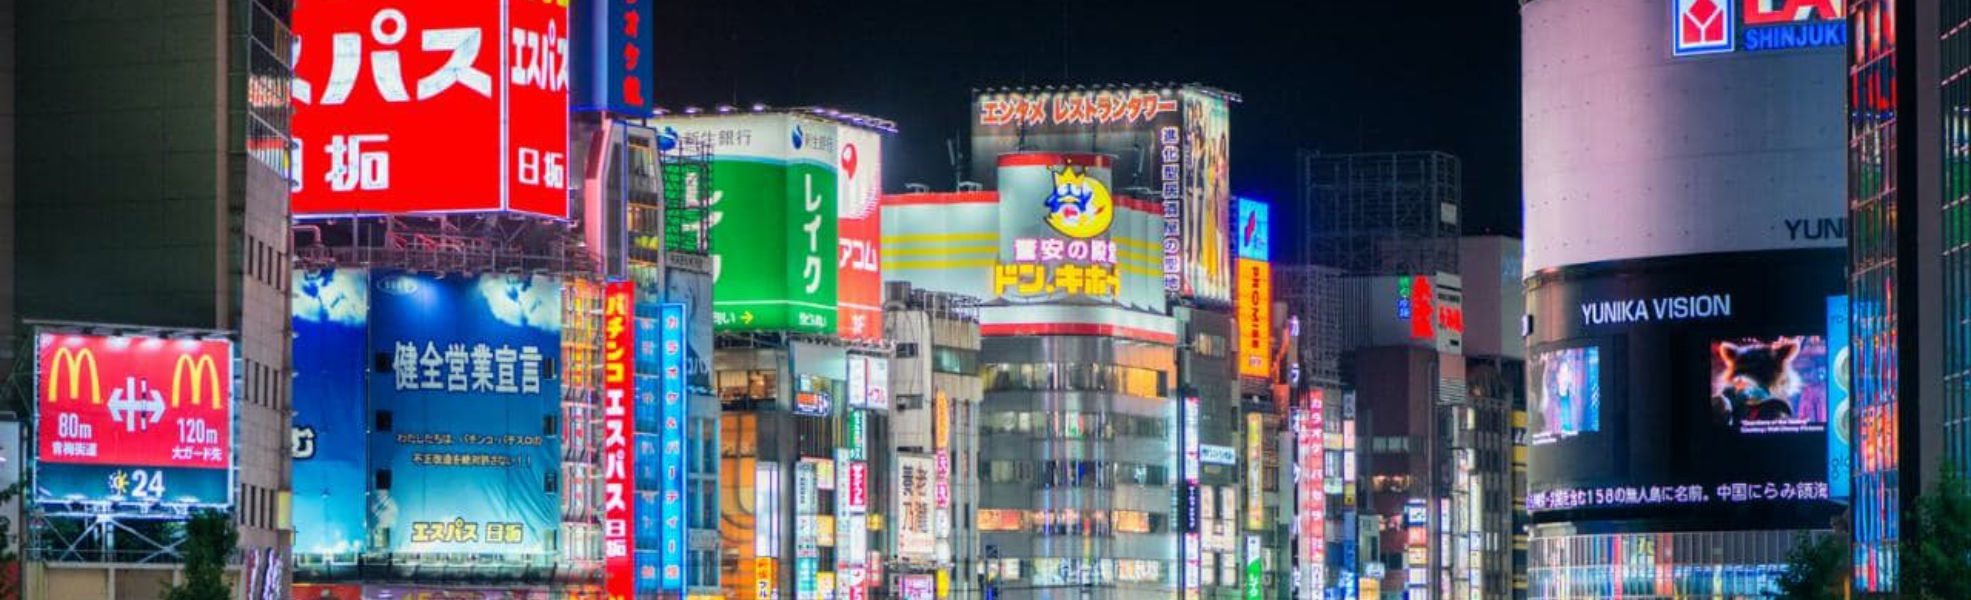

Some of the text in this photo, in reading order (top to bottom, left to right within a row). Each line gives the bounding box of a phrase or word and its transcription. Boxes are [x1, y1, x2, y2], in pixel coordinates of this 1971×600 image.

[981, 94, 1177, 125] エンタメ レストランタワー
[519, 147, 564, 189] 日拓
[803, 173, 822, 294] レイク
[1581, 294, 1731, 325] YUNIKA VISION
[605, 294, 626, 382] パチンコ
[393, 341, 543, 394] 健全営業宣言
[58, 413, 92, 438] 80m
[177, 418, 219, 444] 120m
[605, 389, 627, 511] エスパス
[131, 469, 166, 497] 24
[411, 517, 477, 543] エスパス
